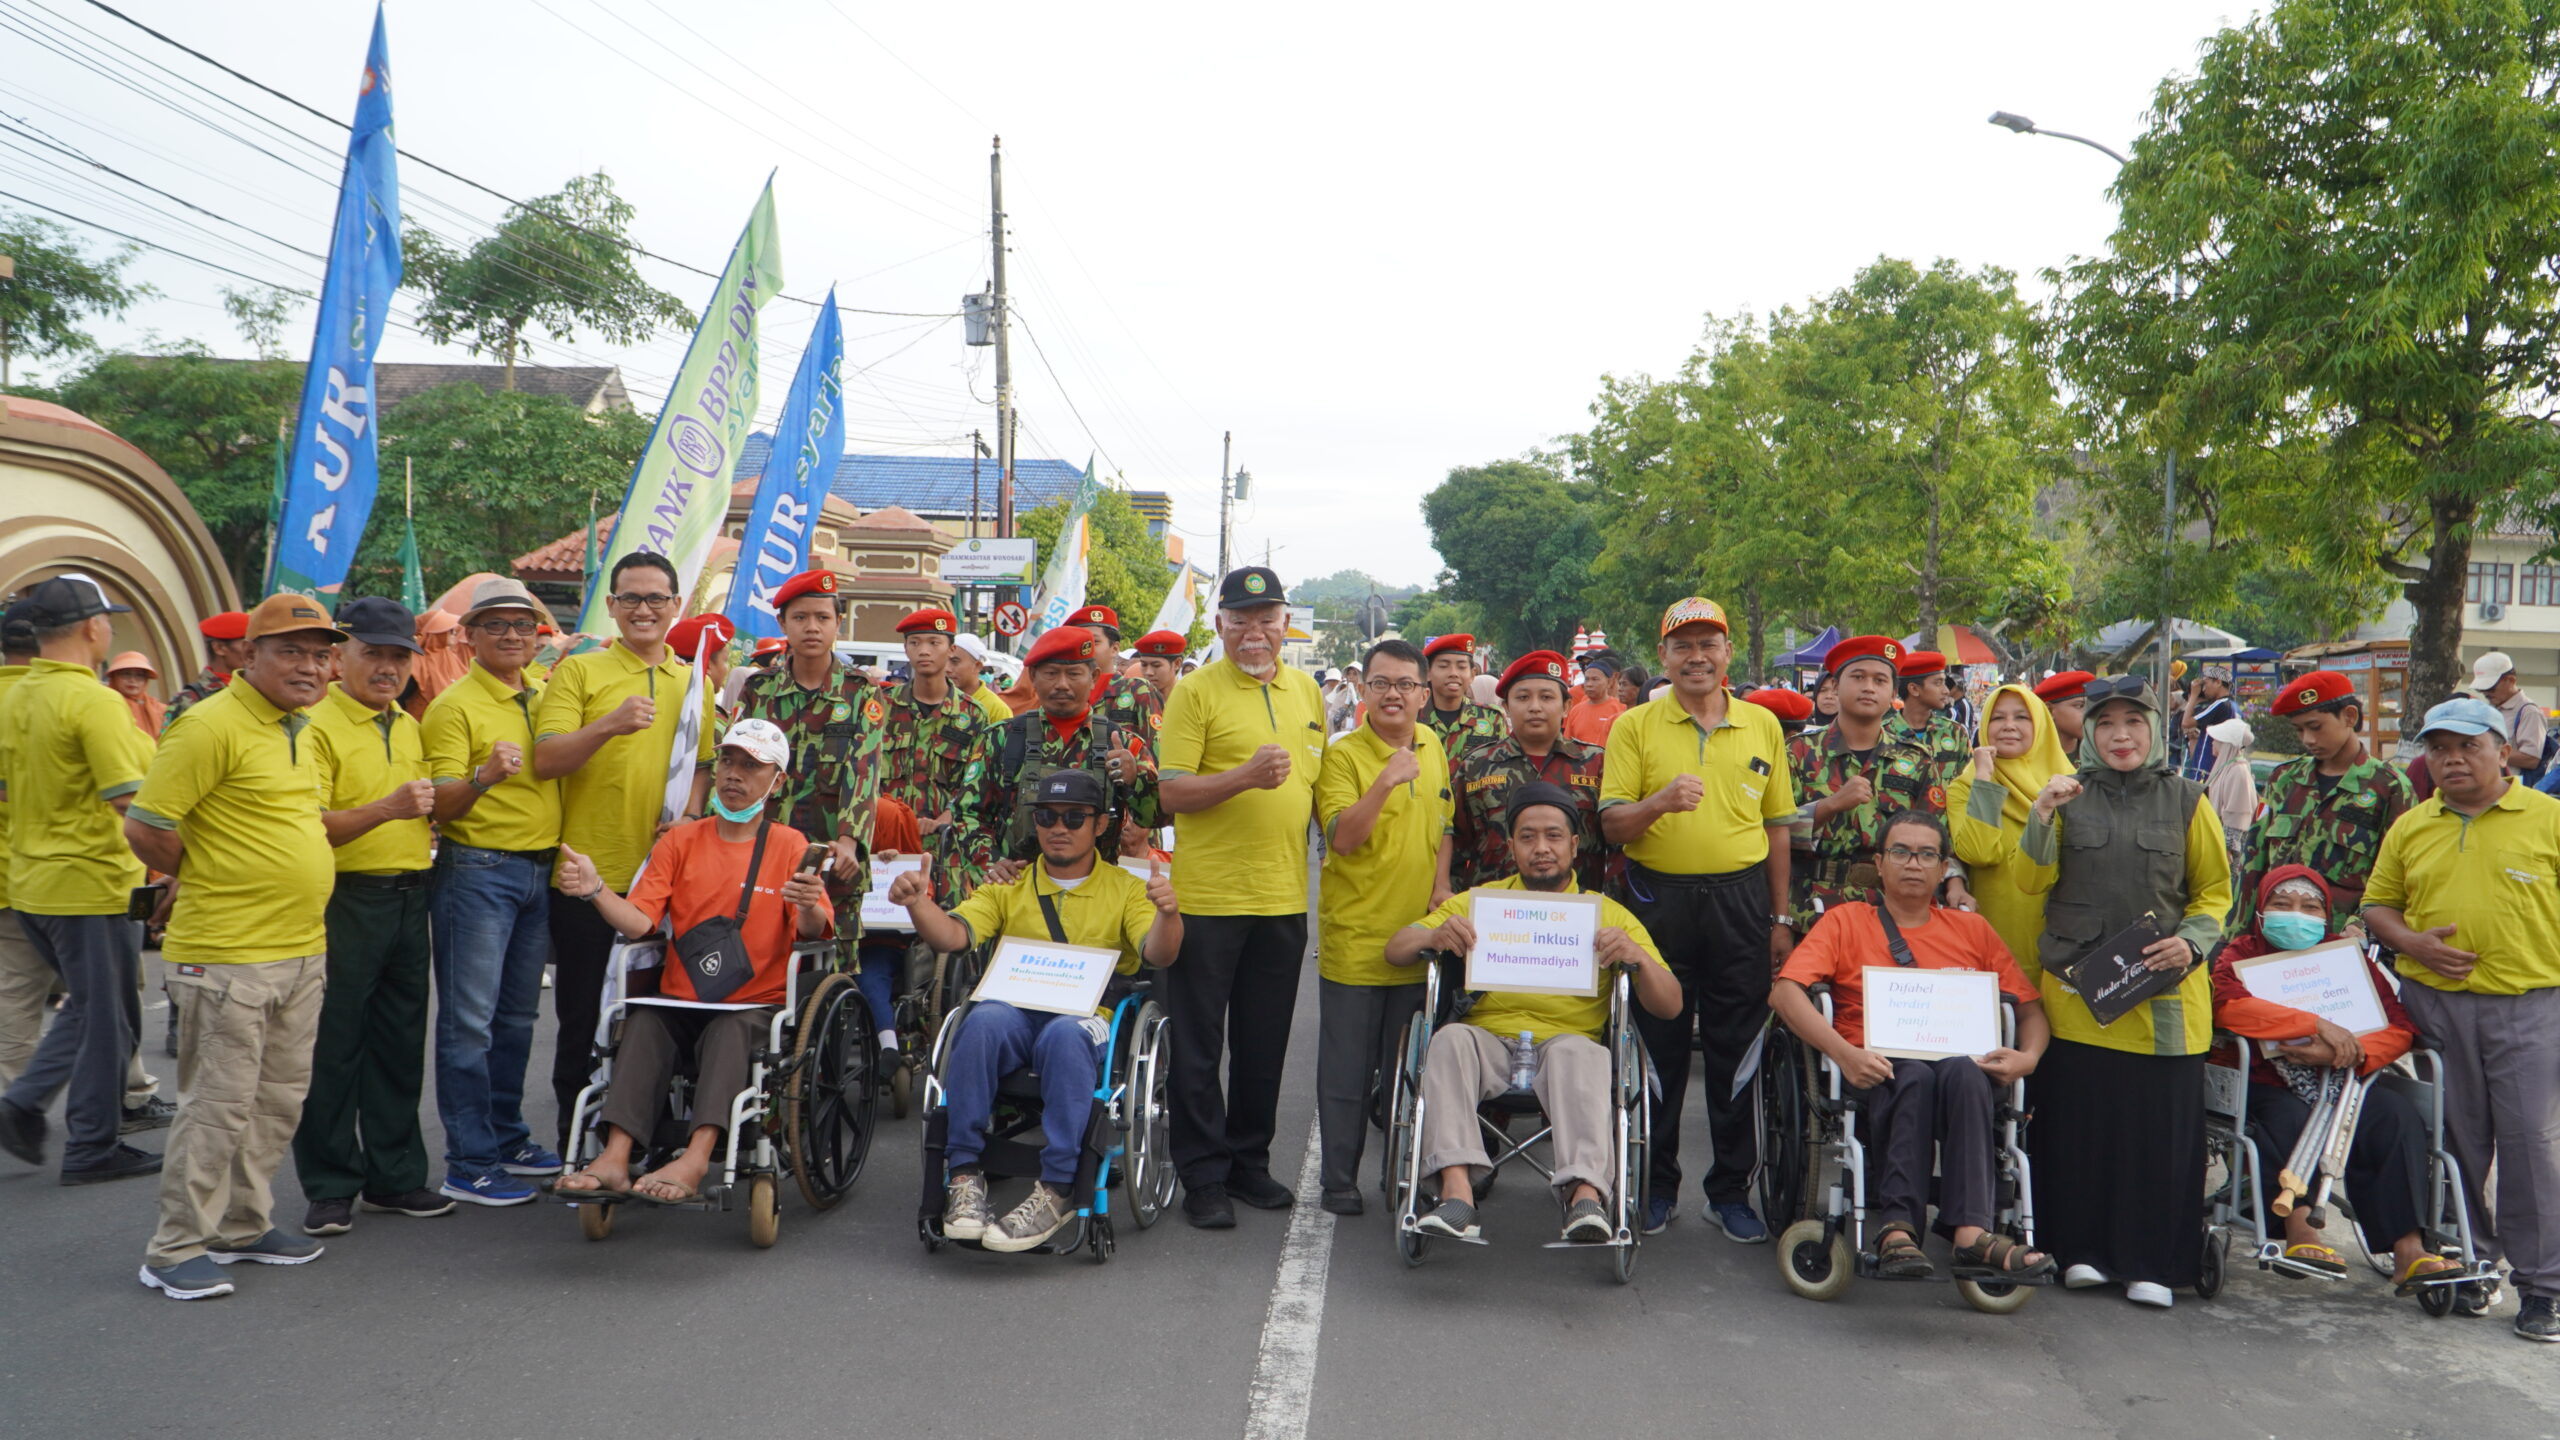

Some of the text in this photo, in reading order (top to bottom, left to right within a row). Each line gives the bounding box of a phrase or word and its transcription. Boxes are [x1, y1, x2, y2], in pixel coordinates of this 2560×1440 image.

[697, 339, 739, 425] BPD
[729, 262, 758, 343] DIY
[795, 335, 844, 487] syaria
[748, 492, 808, 617] KUR
[1042, 596, 1070, 629] BSI
[861, 907, 895, 915] emangat
[1503, 909, 1567, 922] HIDIMU GK
[1488, 932, 1579, 946] wujud inklusi
[1020, 954, 1086, 970] Difabel
[1487, 952, 1579, 968] Muhammadiyah
[1011, 967, 1085, 980] Muhammadiyah
[2282, 963, 2321, 980] Difabel
[1888, 981, 1934, 994] Difabel
[2094, 980, 2122, 1003] Master
[2121, 970, 2129, 985] of
[2281, 976, 2332, 993] Berjuang
[2322, 985, 2349, 999] demi
[1888, 998, 1931, 1009] berdiri
[1896, 1016, 1929, 1027] panji
[1914, 1031, 1949, 1044] Islam
